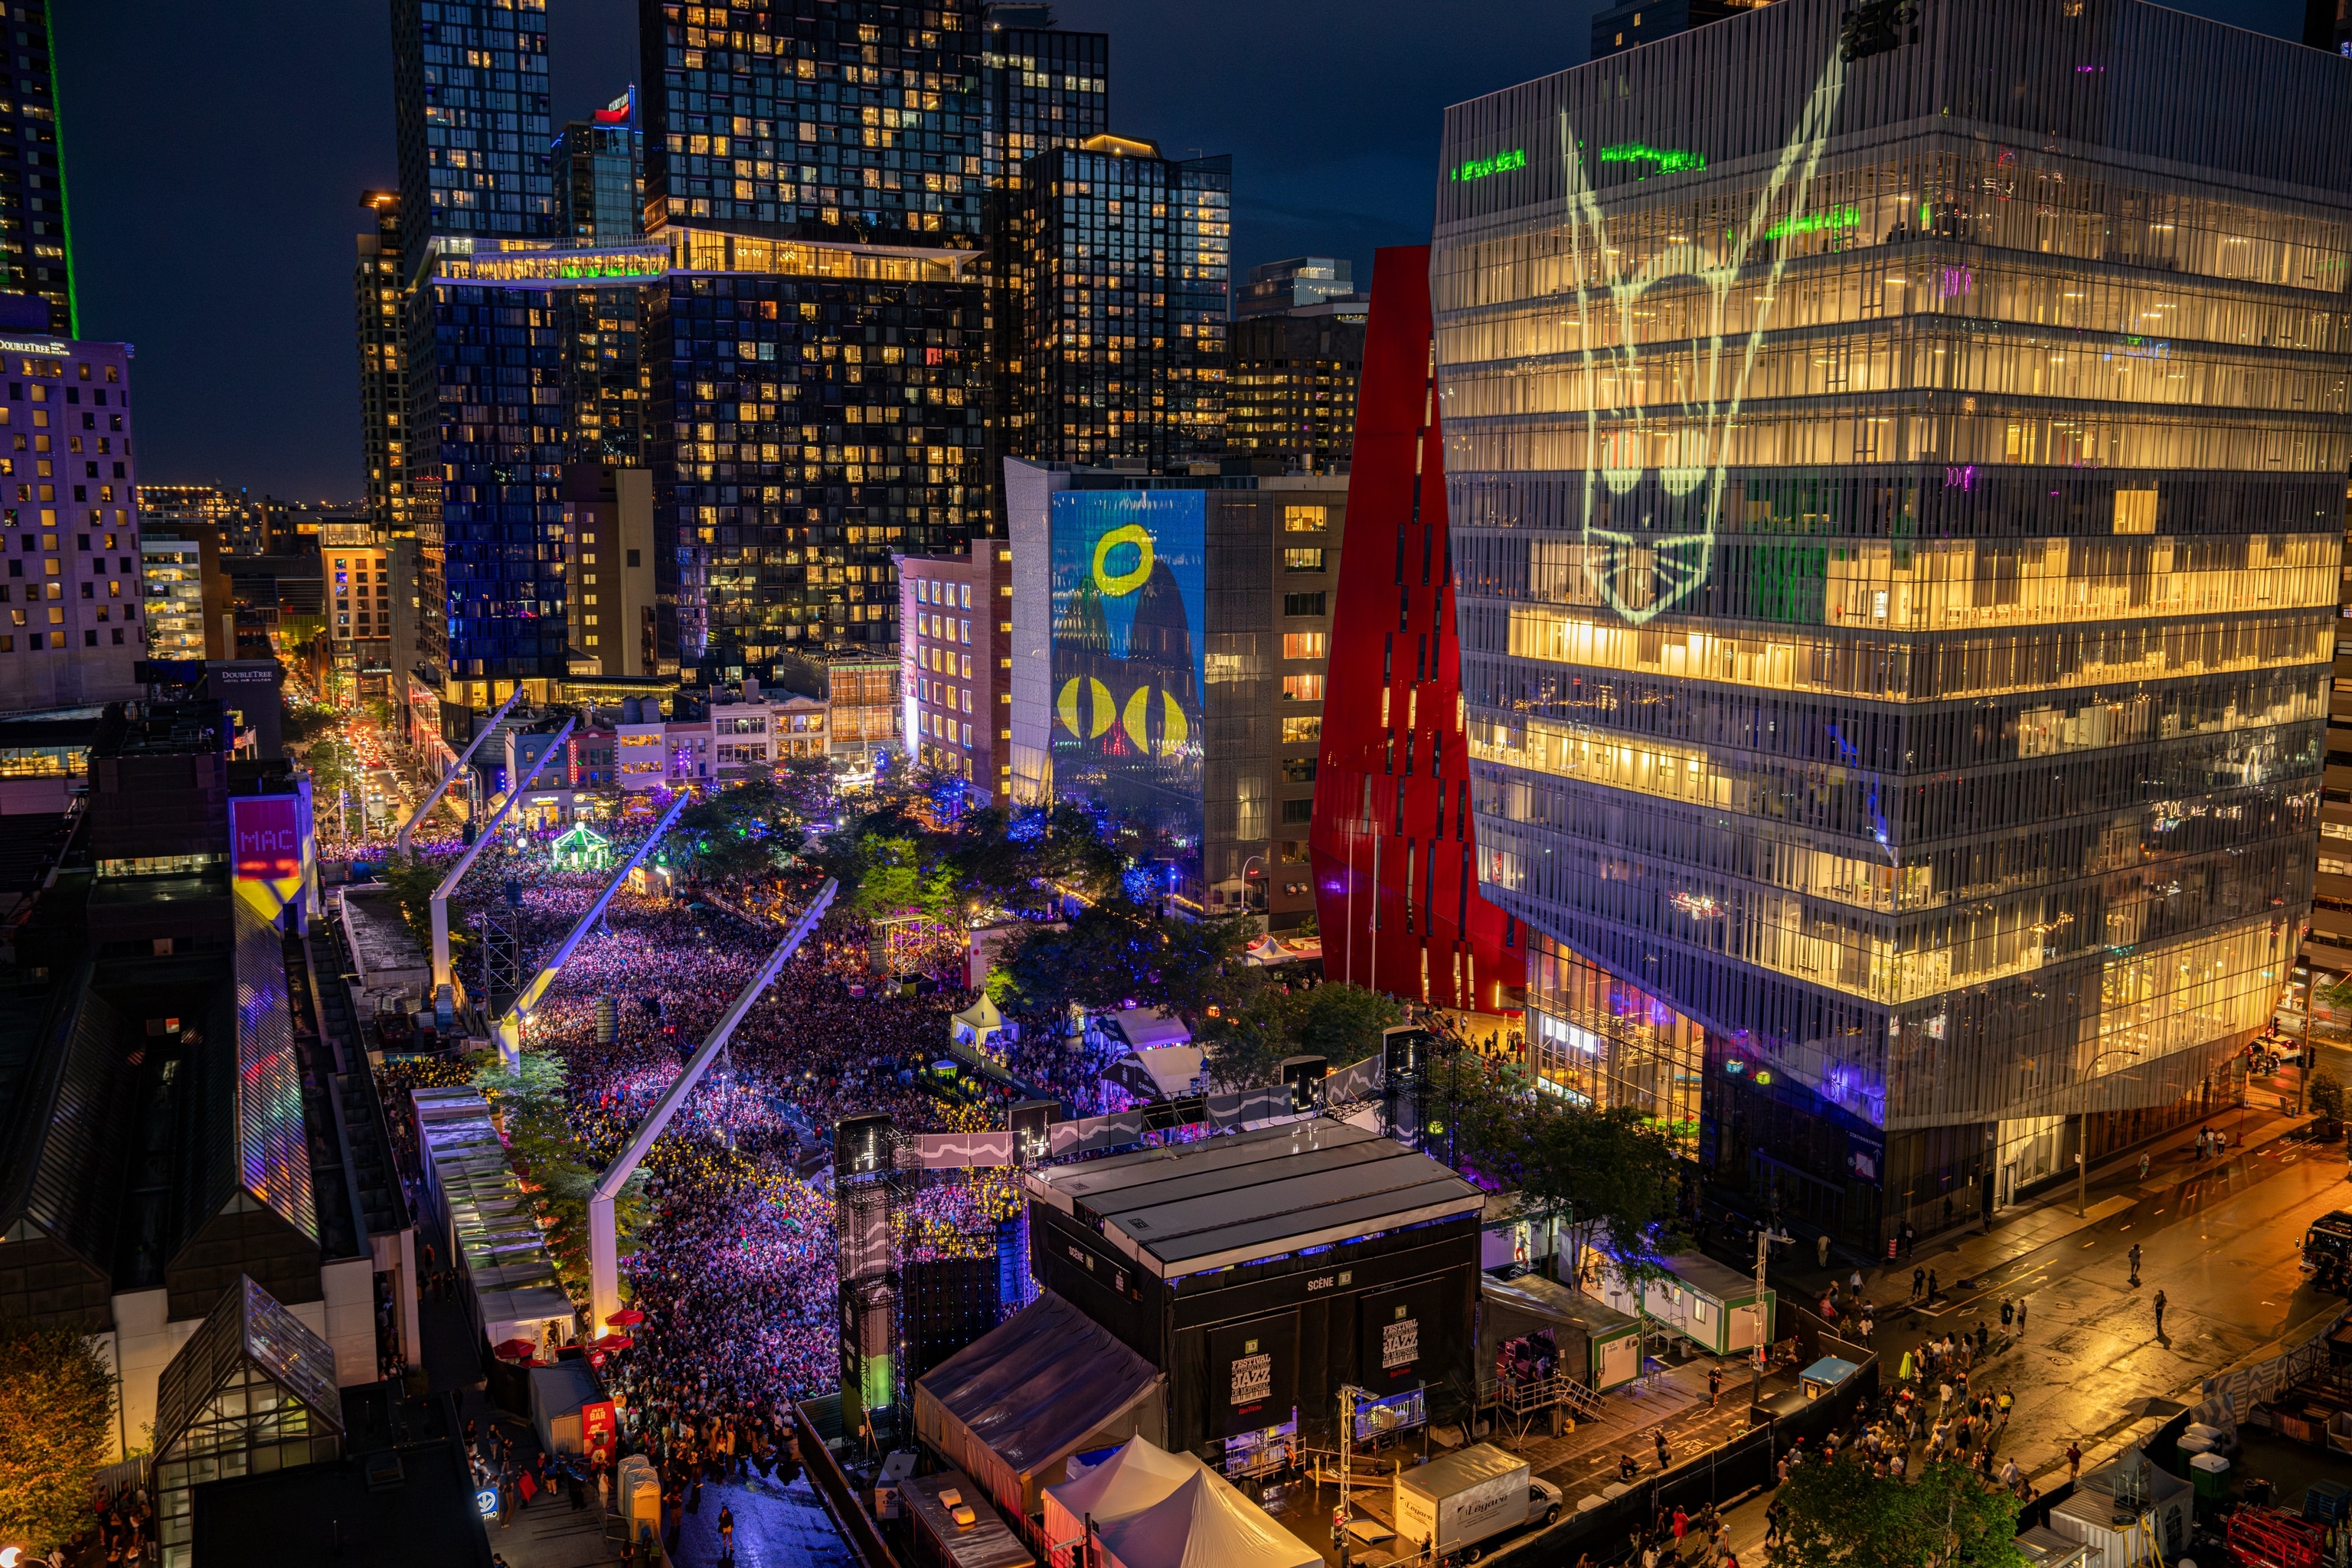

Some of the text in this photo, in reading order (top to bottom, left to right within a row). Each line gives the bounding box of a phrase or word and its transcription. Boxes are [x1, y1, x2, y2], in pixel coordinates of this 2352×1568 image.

[240, 829, 293, 852] MAC
[1142, 1083, 1156, 1095] ROGERS
[1308, 1276, 1334, 1292] SCÈNE
[1383, 1318, 1418, 1334] FESTIVAL
[1383, 1331, 1418, 1354] JAZZ
[1232, 1354, 1271, 1368] FESTIVAL
[1231, 1367, 1271, 1390] JAZZ
[590, 1411, 606, 1422] BAR
